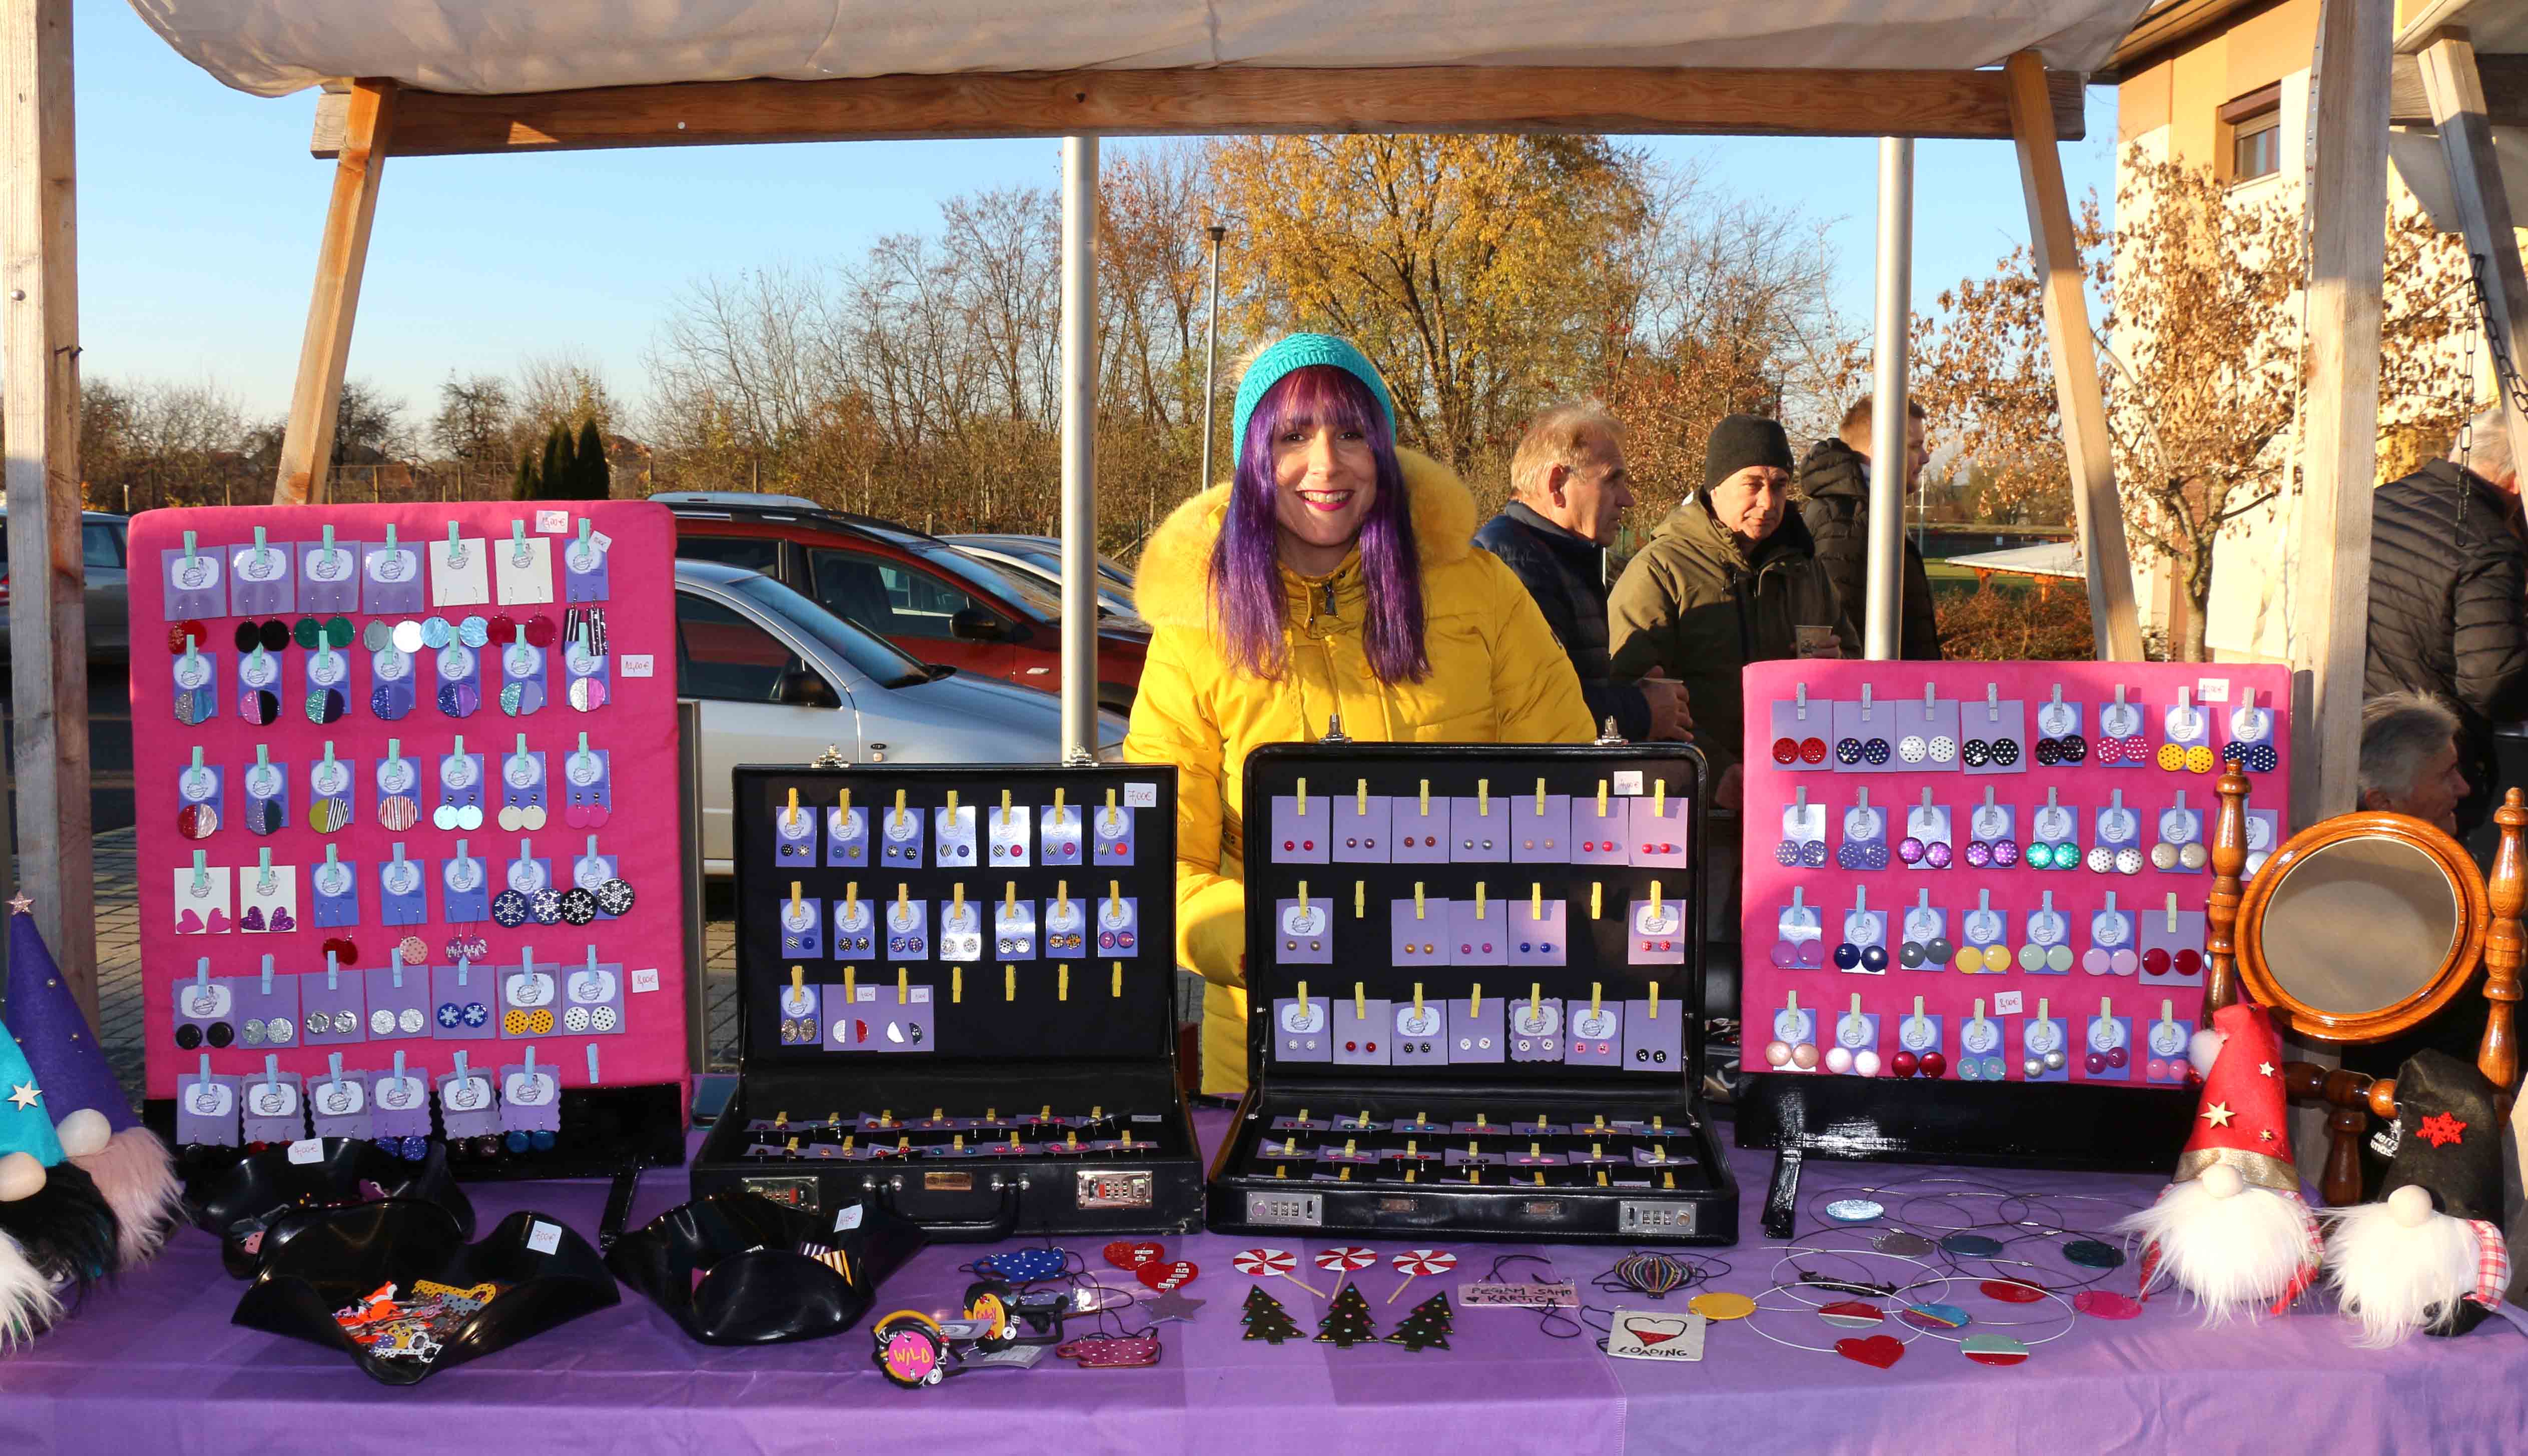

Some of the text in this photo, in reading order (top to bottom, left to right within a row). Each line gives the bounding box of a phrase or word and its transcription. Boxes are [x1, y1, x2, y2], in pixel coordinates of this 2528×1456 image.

[1128, 790, 1153, 805] 7,00€
[893, 1347, 931, 1366] WILD
[1618, 1346, 1688, 1356] LOADING
